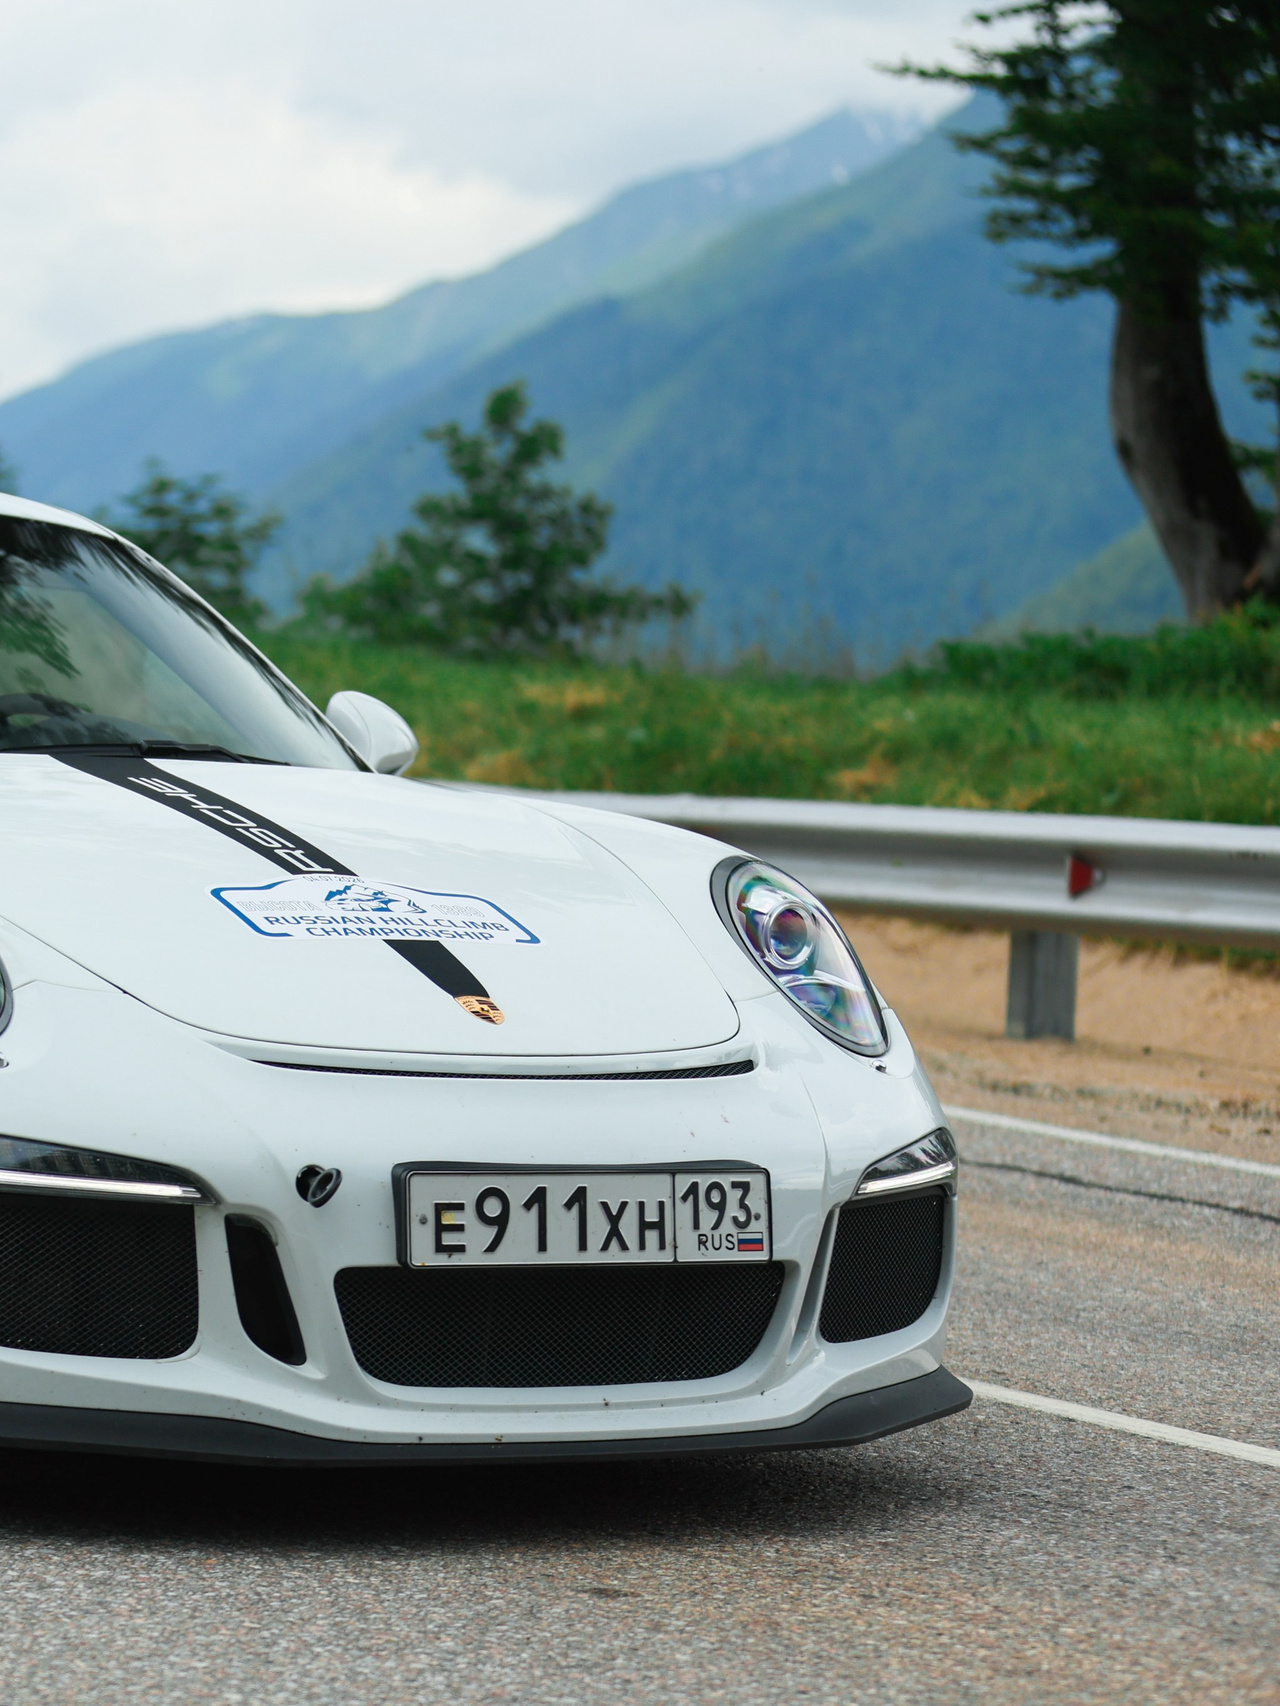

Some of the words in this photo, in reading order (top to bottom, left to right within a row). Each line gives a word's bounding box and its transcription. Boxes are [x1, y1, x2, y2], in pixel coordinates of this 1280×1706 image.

[236, 900, 322, 912] ВЫСОТА
[263, 915, 377, 925] RUSSIAN
[378, 916, 510, 932] HILLCLIMB
[305, 927, 495, 941] CHAMPIONSHIP
[679, 1180, 752, 1231] 193
[697, 1233, 736, 1251] RUS
